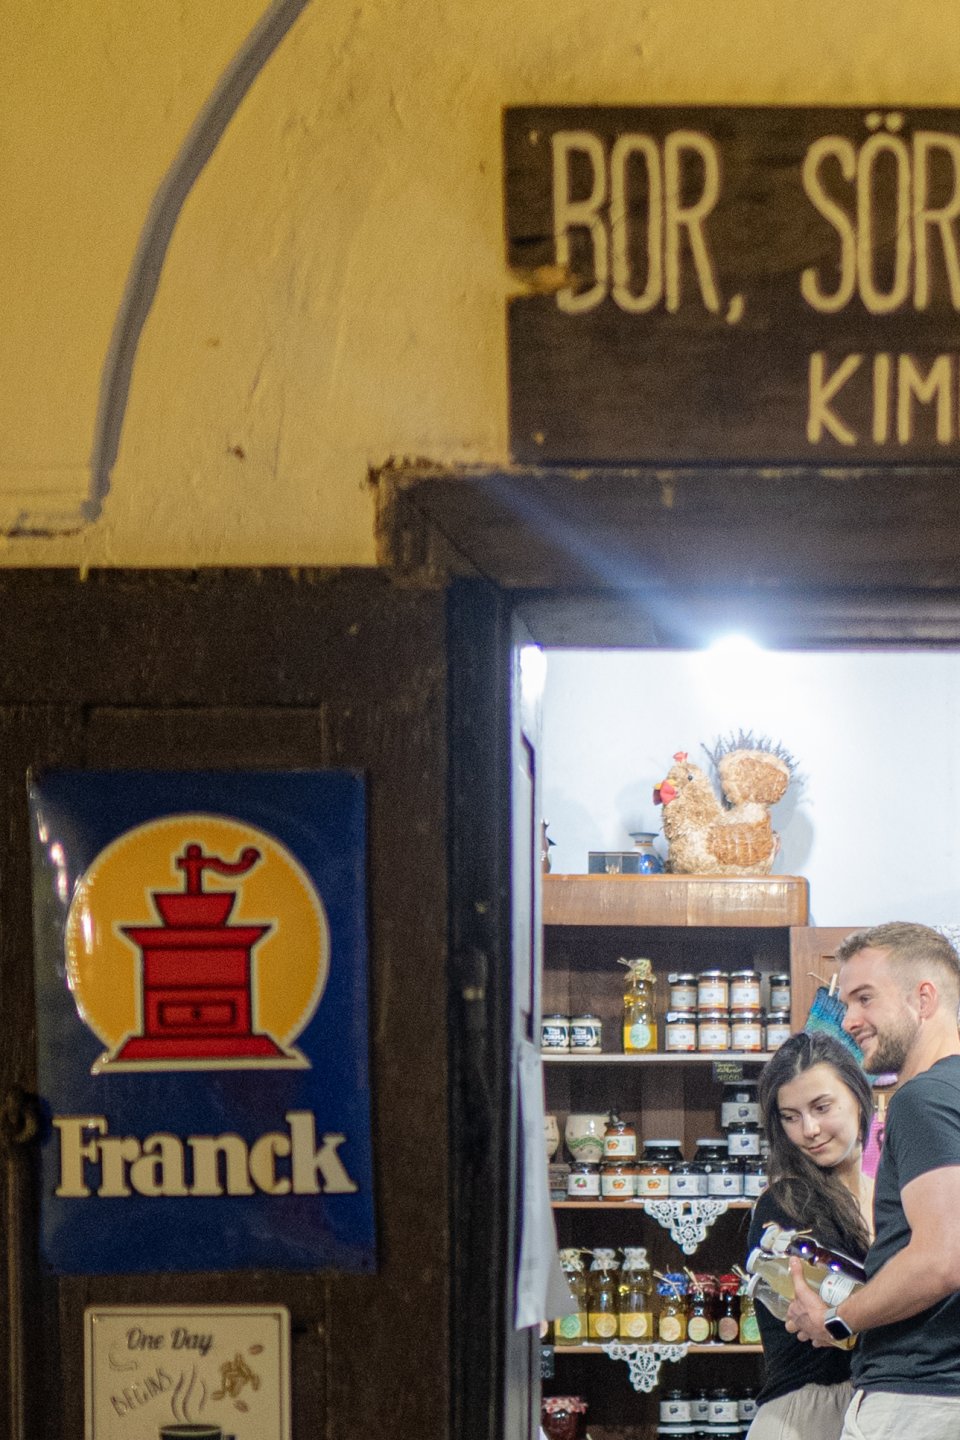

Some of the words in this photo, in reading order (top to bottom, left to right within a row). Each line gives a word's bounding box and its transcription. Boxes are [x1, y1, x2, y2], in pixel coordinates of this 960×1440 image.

[549, 127, 745, 326] BOR,
[52, 1109, 358, 1198] Franck
[125, 1326, 164, 1351] One
[169, 1327, 216, 1357] Day
